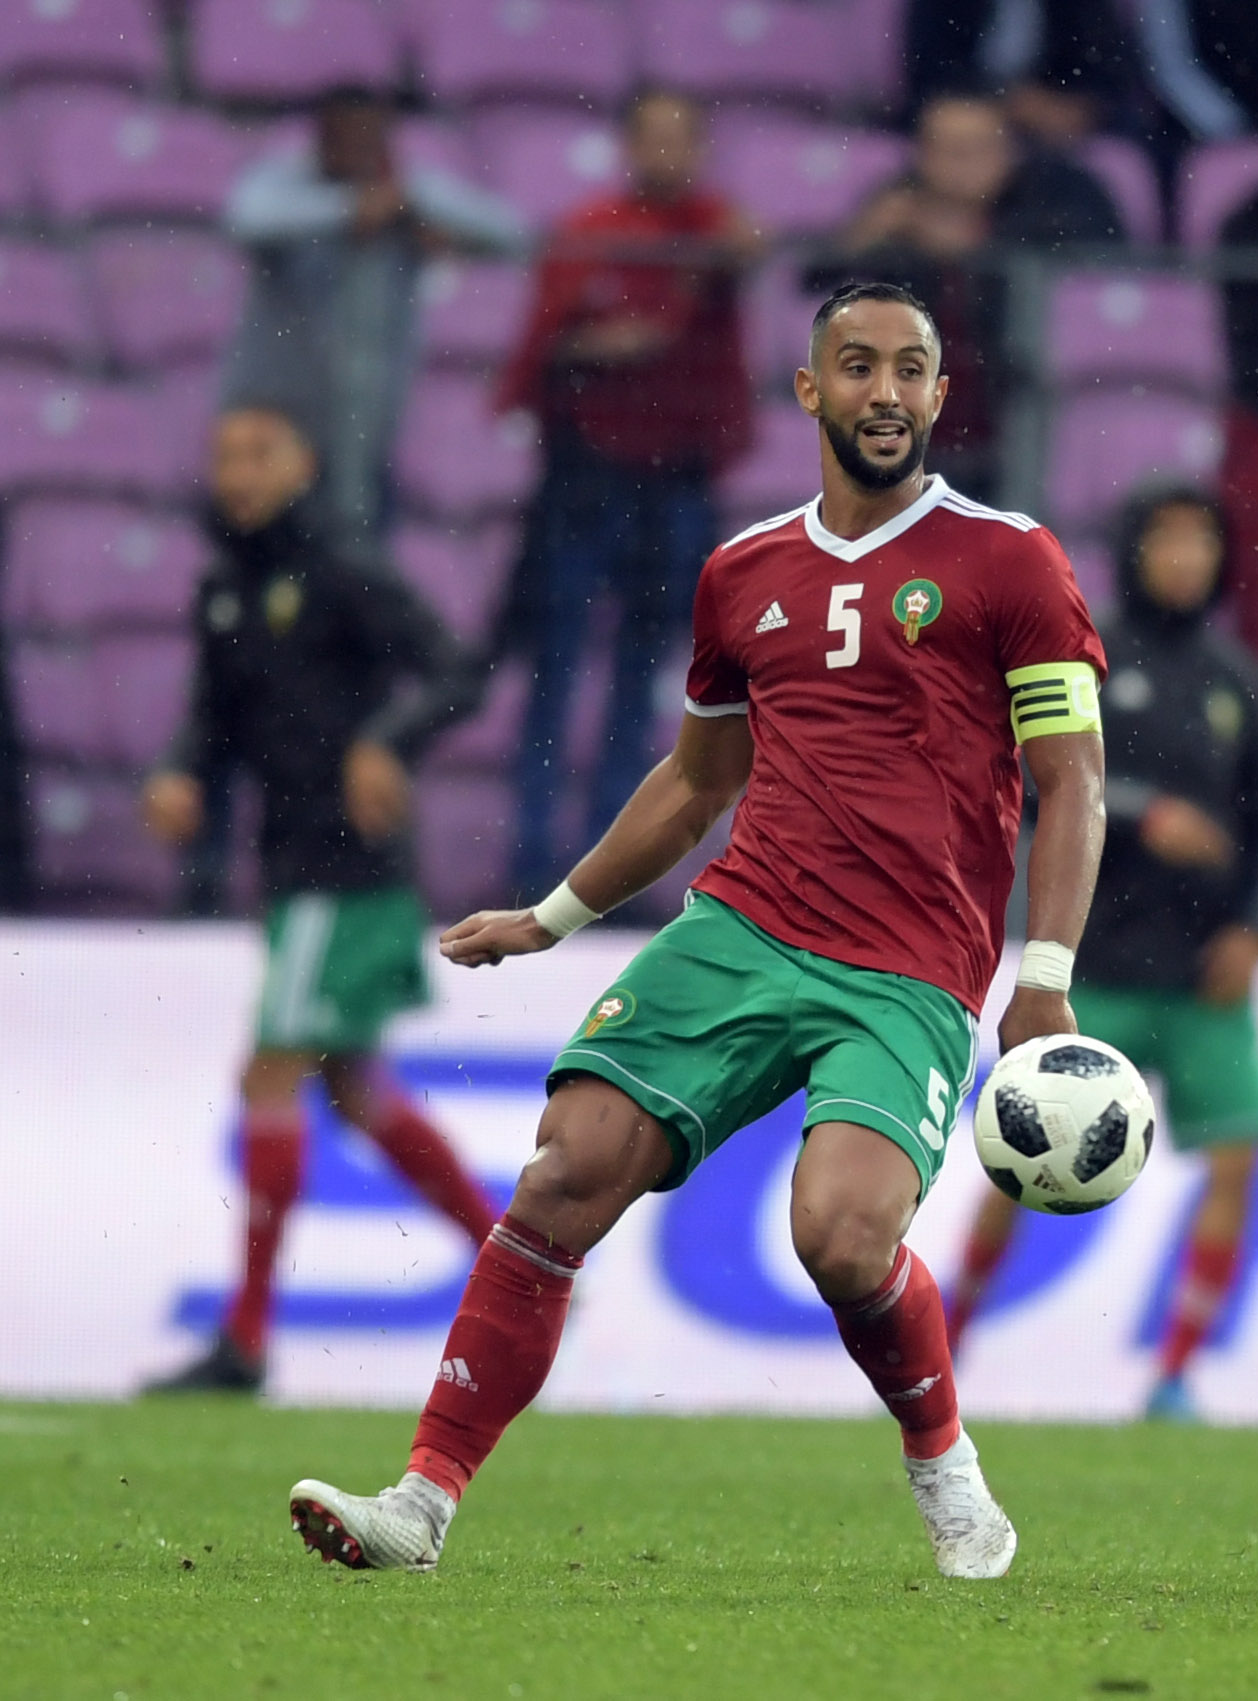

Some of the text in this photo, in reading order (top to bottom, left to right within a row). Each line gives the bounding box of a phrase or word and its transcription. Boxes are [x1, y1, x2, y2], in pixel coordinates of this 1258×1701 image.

[755, 617, 789, 634] adidas
[825, 582, 865, 669] 5
[918, 1066, 950, 1151] 5
[436, 1371, 480, 1393] idas
